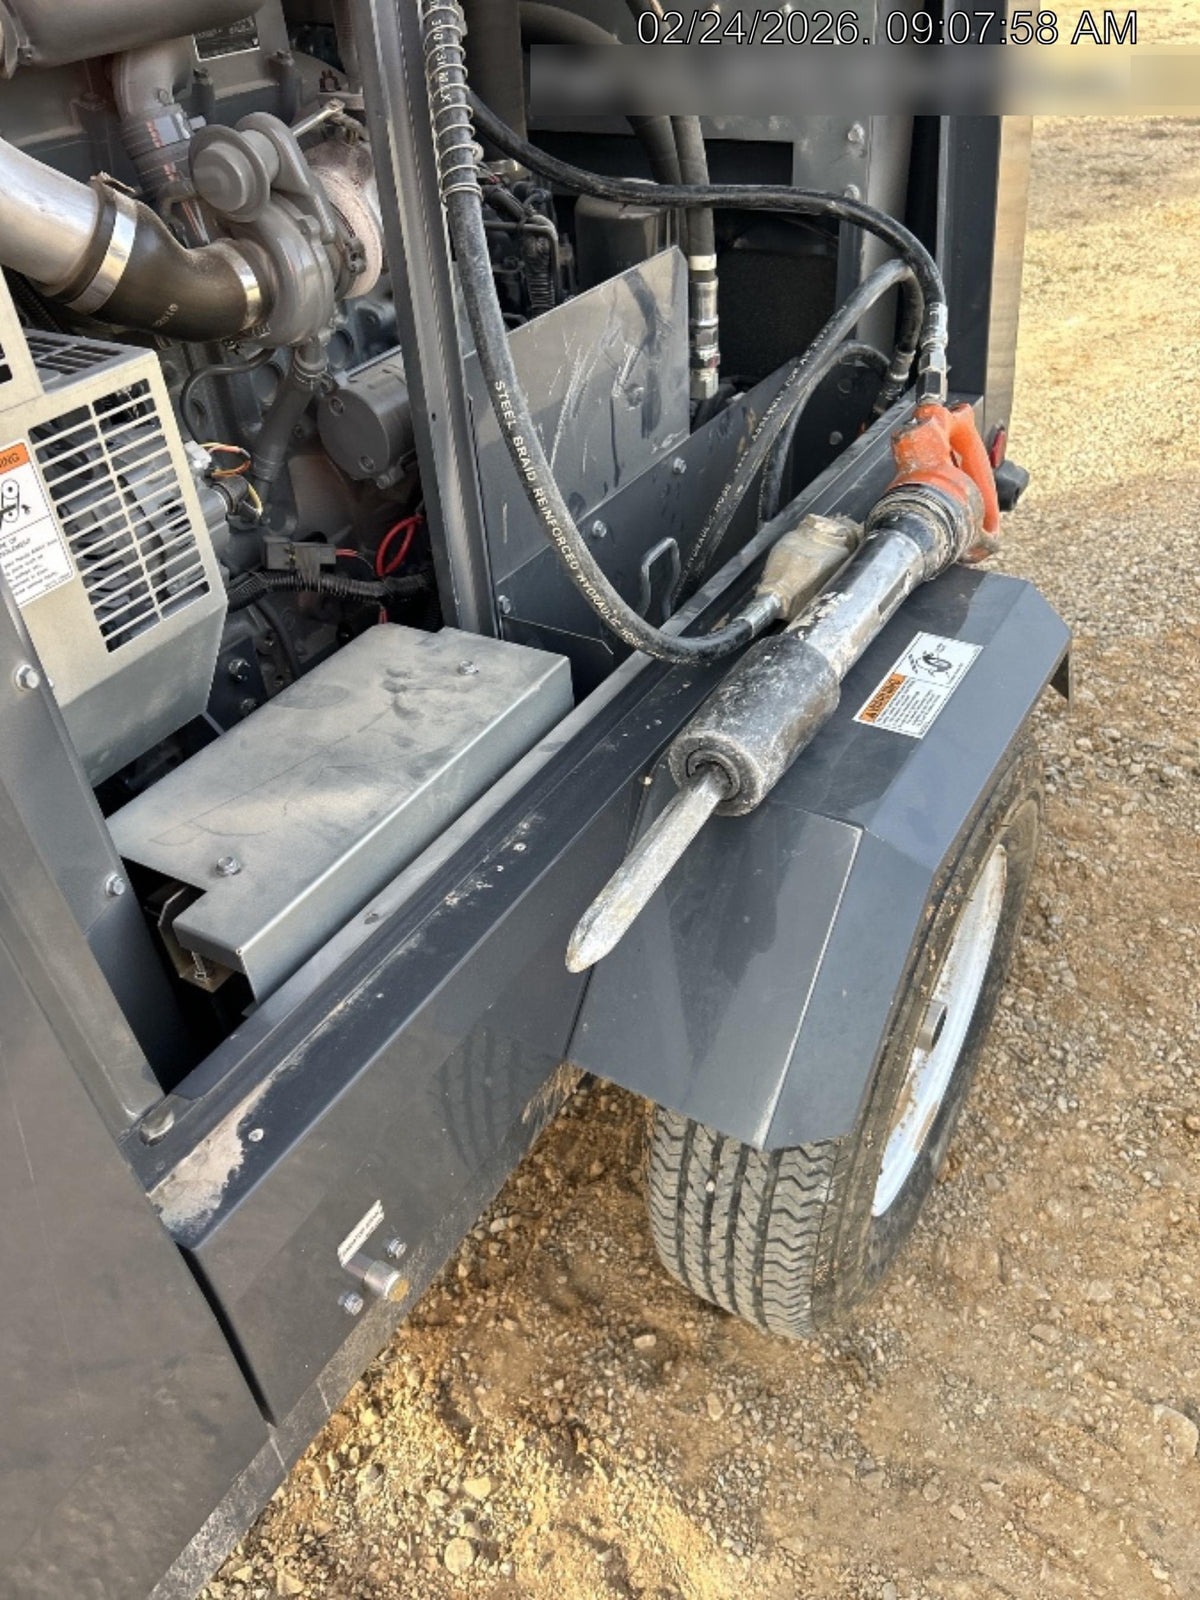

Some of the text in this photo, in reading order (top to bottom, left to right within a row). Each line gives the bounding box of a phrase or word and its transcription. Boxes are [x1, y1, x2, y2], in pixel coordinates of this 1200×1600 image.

[495, 380, 516, 429] STEEL
[513, 435, 537, 481] BRAID
[533, 487, 580, 570] REINFORCED
[576, 570, 622, 628] HYDRAULIC
